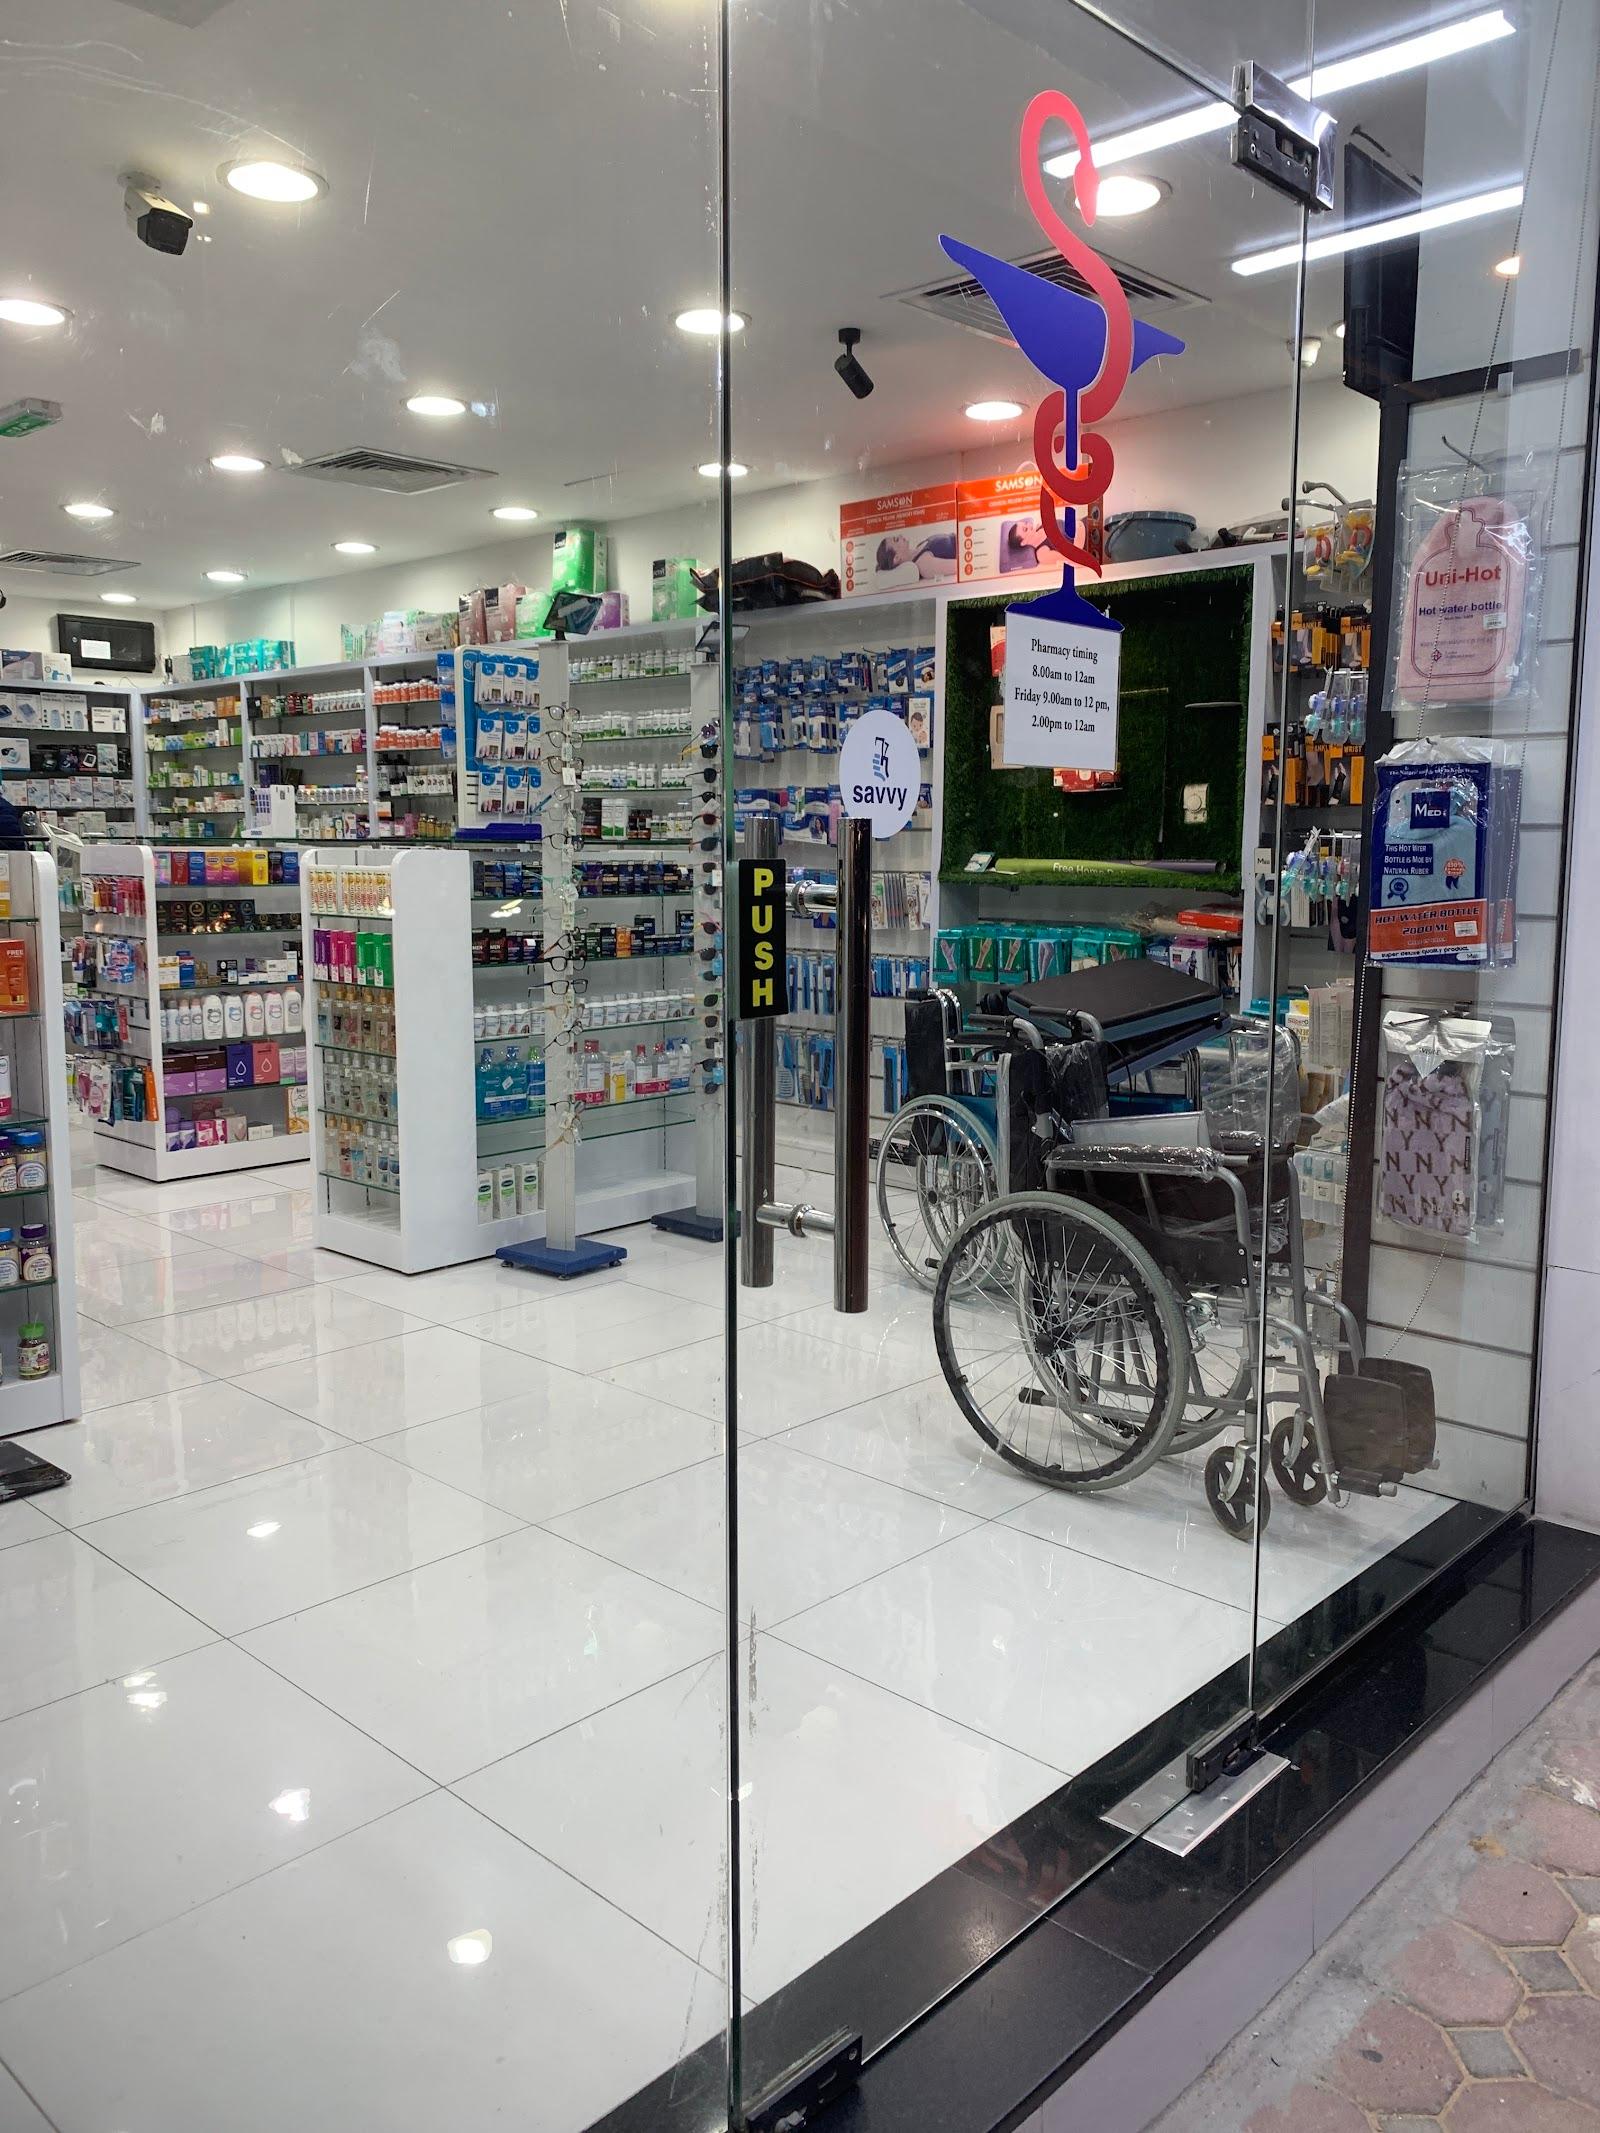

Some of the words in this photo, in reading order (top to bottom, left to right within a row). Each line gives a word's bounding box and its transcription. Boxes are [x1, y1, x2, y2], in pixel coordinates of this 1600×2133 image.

[995, 476, 1043, 493] SAMSON
[877, 496, 913, 510] SAMSON
[1425, 565, 1502, 586] Uni-Hot
[1419, 607, 1436, 616] Hot
[1440, 604, 1469, 613] water
[1471, 601, 1502, 611] bottle
[1031, 638, 1071, 660] Pharmacy
[1073, 646, 1098, 665] timing
[1032, 664, 1062, 680] 8.00am
[1064, 672, 1072, 682] to
[1075, 670, 1095, 684] 12am
[1014, 687, 1041, 706] Friday
[1043, 691, 1072, 706] 9.00am
[1074, 698, 1082, 707] to
[1084, 696, 1094, 708] 12
[1095, 700, 1110, 713] pm,
[1031, 715, 1062, 733] 2.00pm
[1064, 721, 1072, 730] to
[1074, 720, 1095, 732] 12am
[852, 783, 907, 811] savvy
[1399, 844, 1411, 852] HOT
[1053, 863, 1074, 872] Free
[1384, 855, 1405, 864] BOTTLE
[1383, 866, 1409, 875] NATURAL
[1375, 915, 1396, 924] HOT
[1400, 911, 1437, 922] WATER
[1439, 907, 1480, 918] BOTTLE
[751, 867, 774, 1007] PUSH
[1402, 925, 1434, 935] 2000
[1414, 1110, 1432, 1130] N
[1451, 1112, 1472, 1132] N
[1434, 1132, 1449, 1152] Y
[1386, 1151, 1400, 1172] N
[1415, 1152, 1433, 1174] N
[1402, 1174, 1415, 1194] Y
[1434, 1175, 1449, 1196] Y
